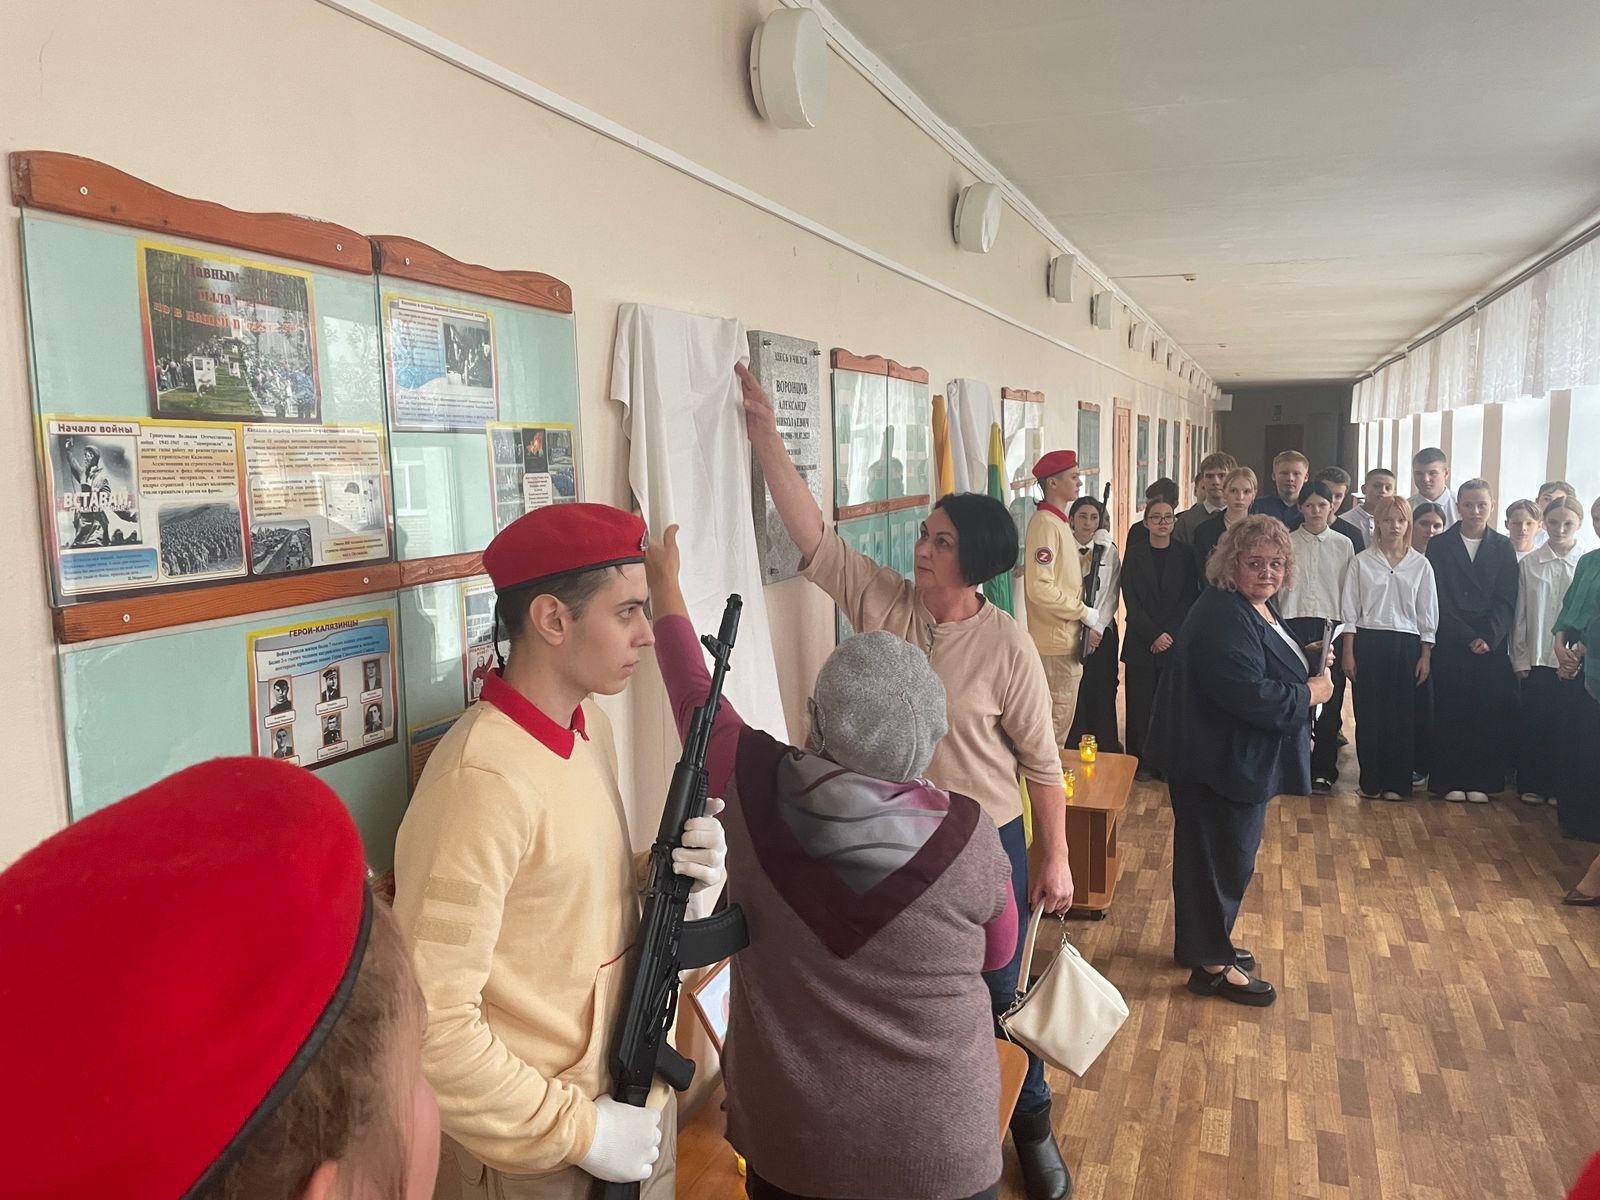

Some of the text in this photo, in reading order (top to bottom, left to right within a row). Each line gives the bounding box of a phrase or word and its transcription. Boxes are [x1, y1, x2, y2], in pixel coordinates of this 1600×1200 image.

[776, 380, 808, 395] ВОРОНЦОВ
[778, 400, 807, 411] АЛЕКСАНДР
[776, 417, 809, 428] НИКОЛАЕВИЧ
[58, 424, 133, 434] Начало войны
[1039, 551, 1050, 562] Z
[289, 620, 359, 638] ГЕРОИ-КАЛЯЗИНЦЫ
